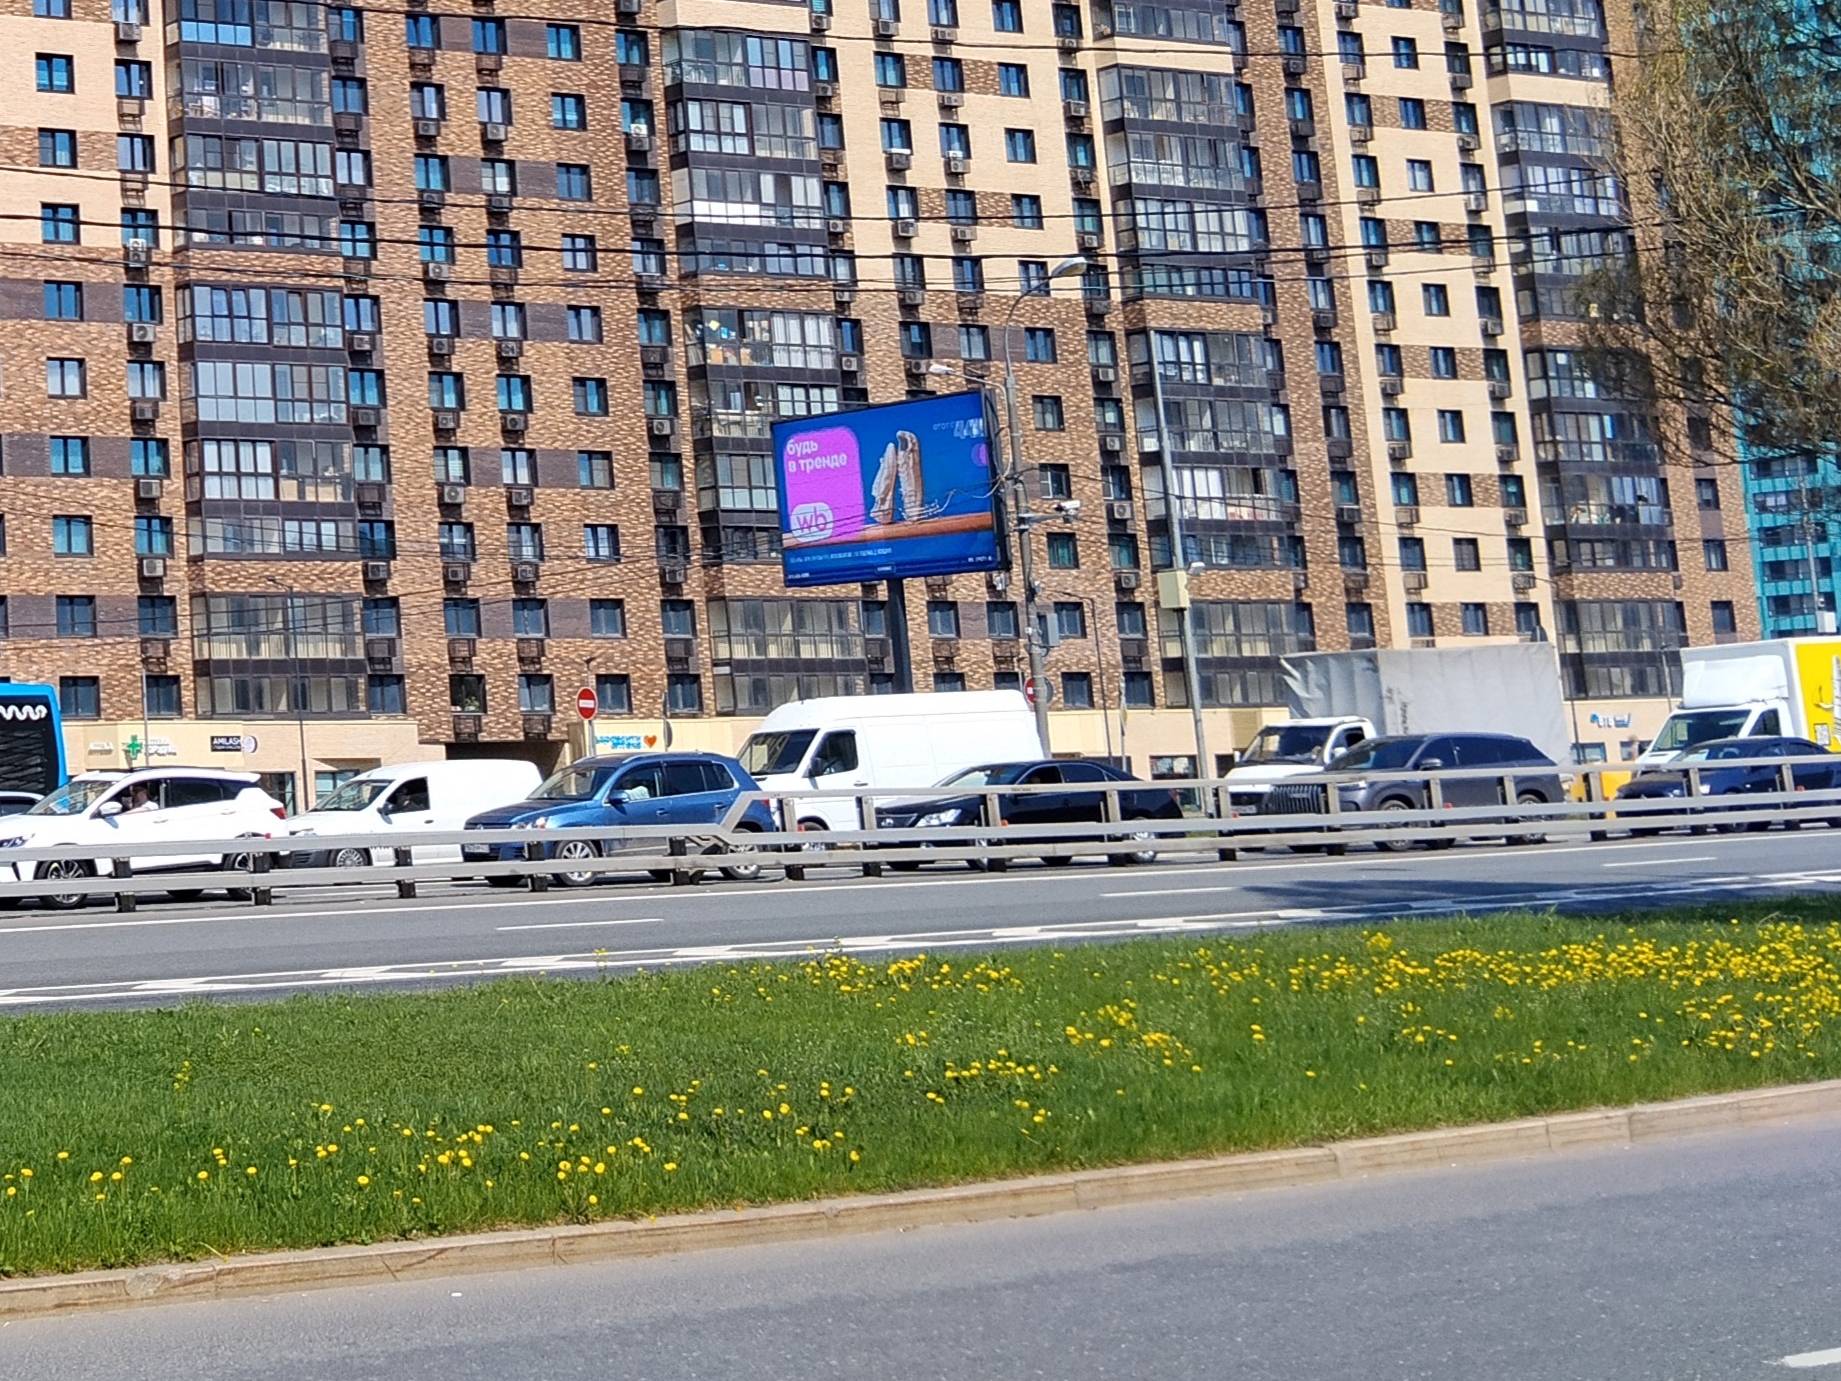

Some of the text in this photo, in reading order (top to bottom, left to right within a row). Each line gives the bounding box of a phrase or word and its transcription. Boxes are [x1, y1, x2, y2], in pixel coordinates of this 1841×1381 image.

[786, 439, 818, 457] будь
[788, 453, 848, 474] в тренде
